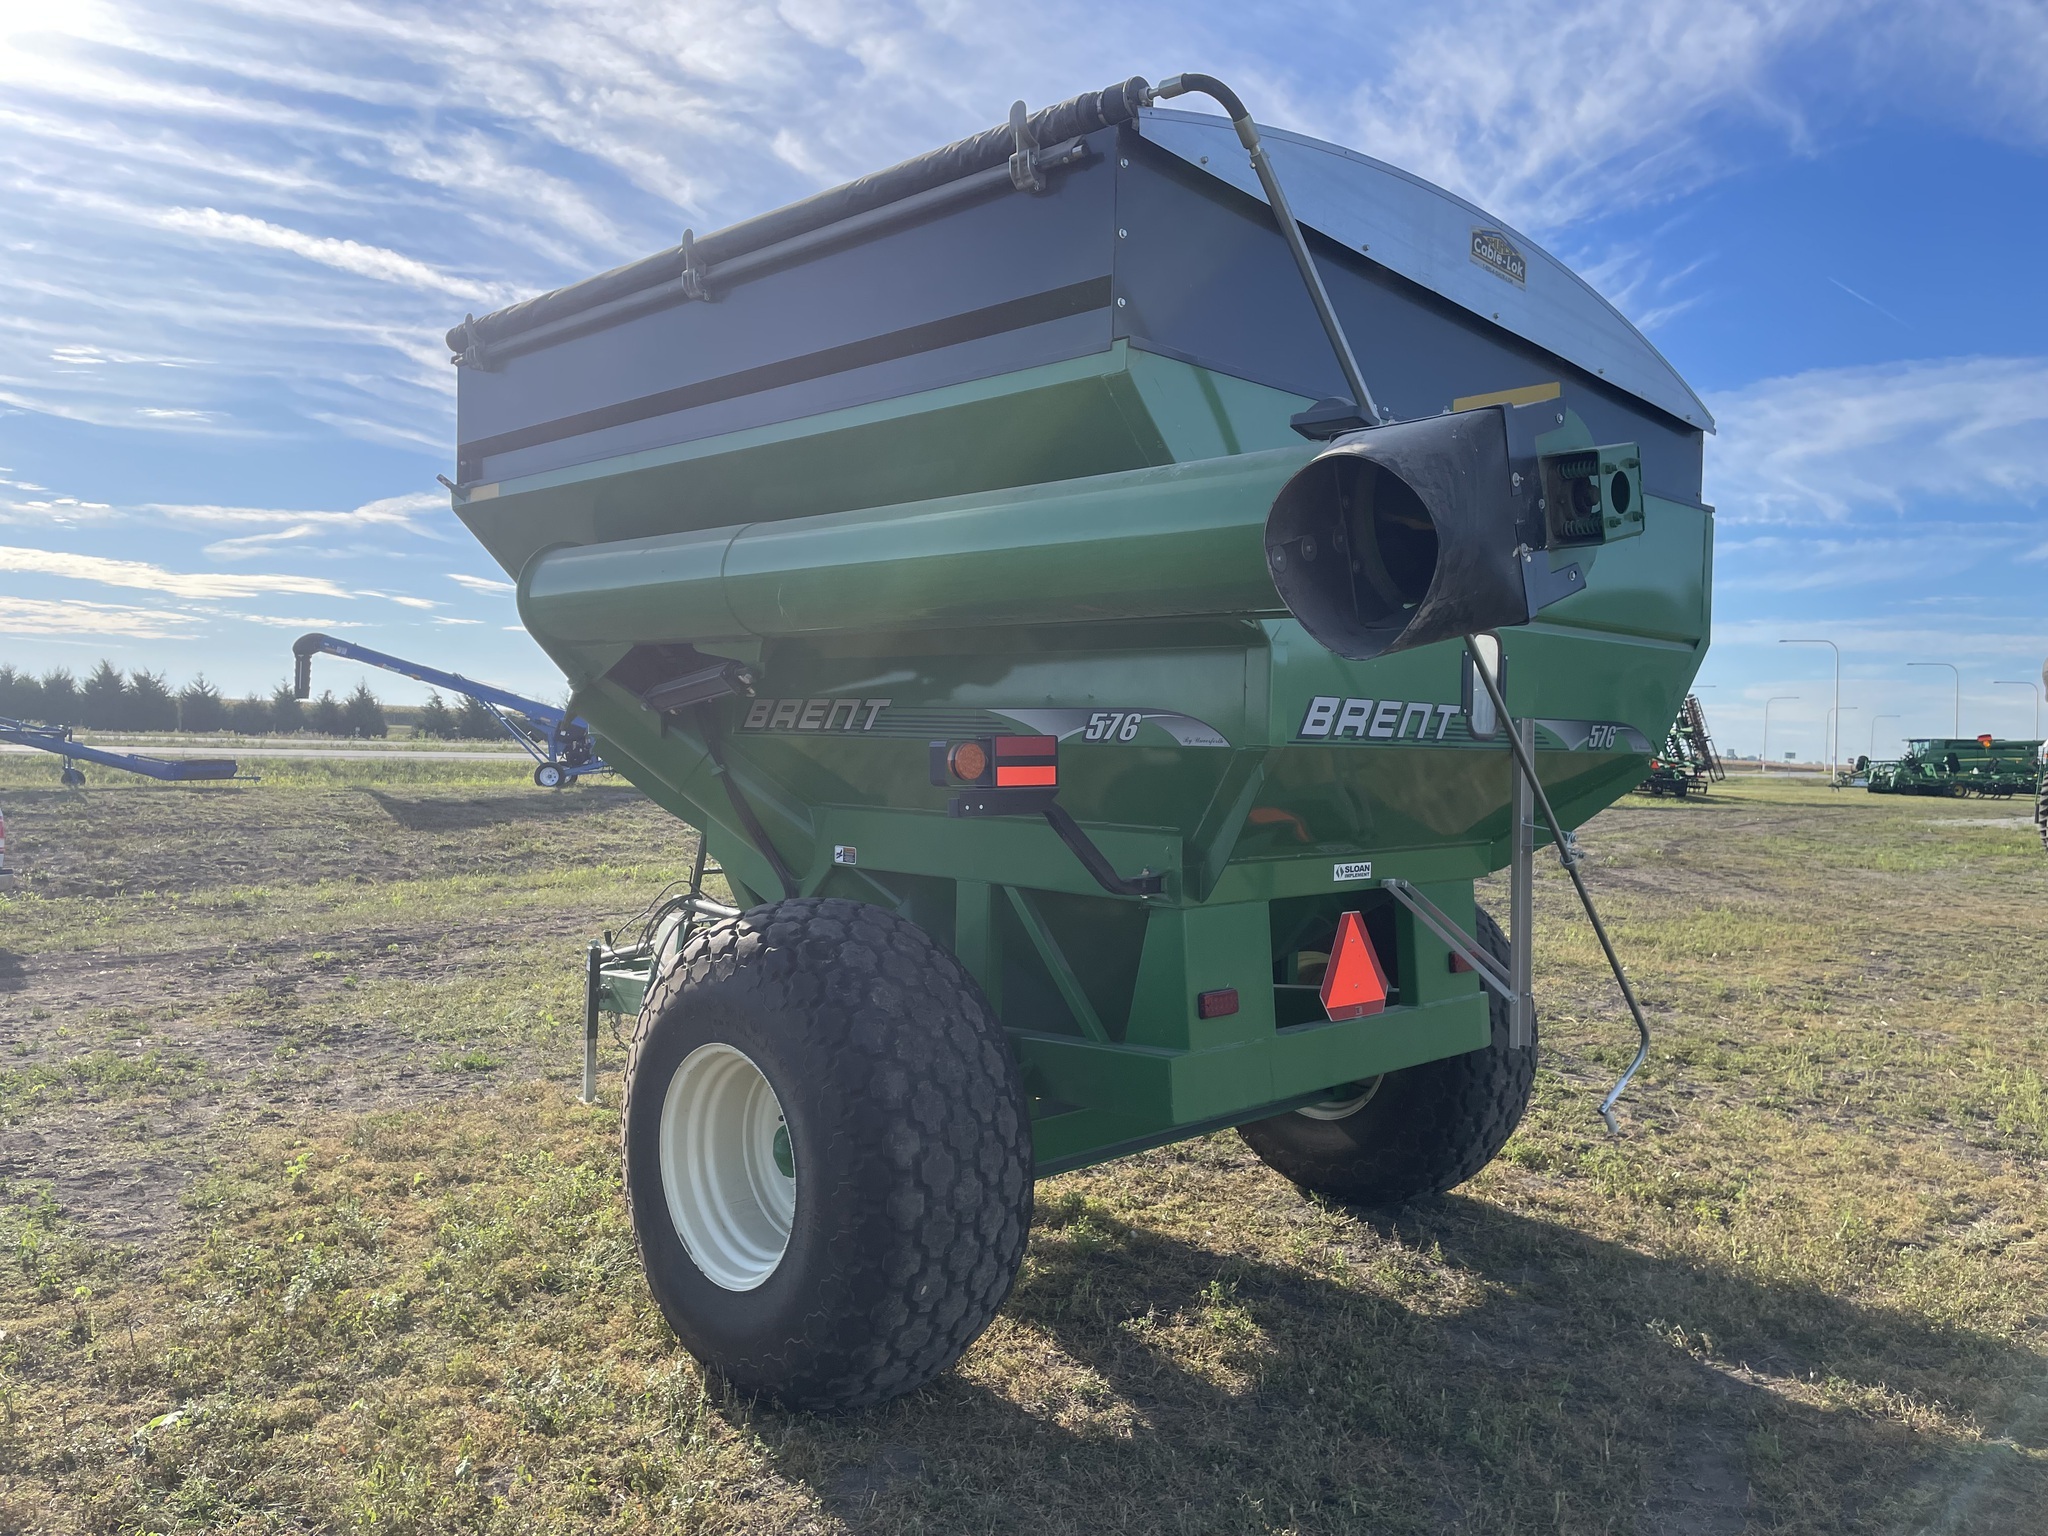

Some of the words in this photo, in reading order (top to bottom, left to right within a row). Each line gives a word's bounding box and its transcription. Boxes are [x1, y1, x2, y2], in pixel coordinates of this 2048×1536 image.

[1473, 237, 1524, 277] Cable-Lok
[743, 698, 893, 731] BRENT
[1084, 712, 1142, 741] 576
[1300, 695, 1462, 740] BRENT
[1588, 724, 1617, 749] 576
[1344, 864, 1370, 873] SLOAN
